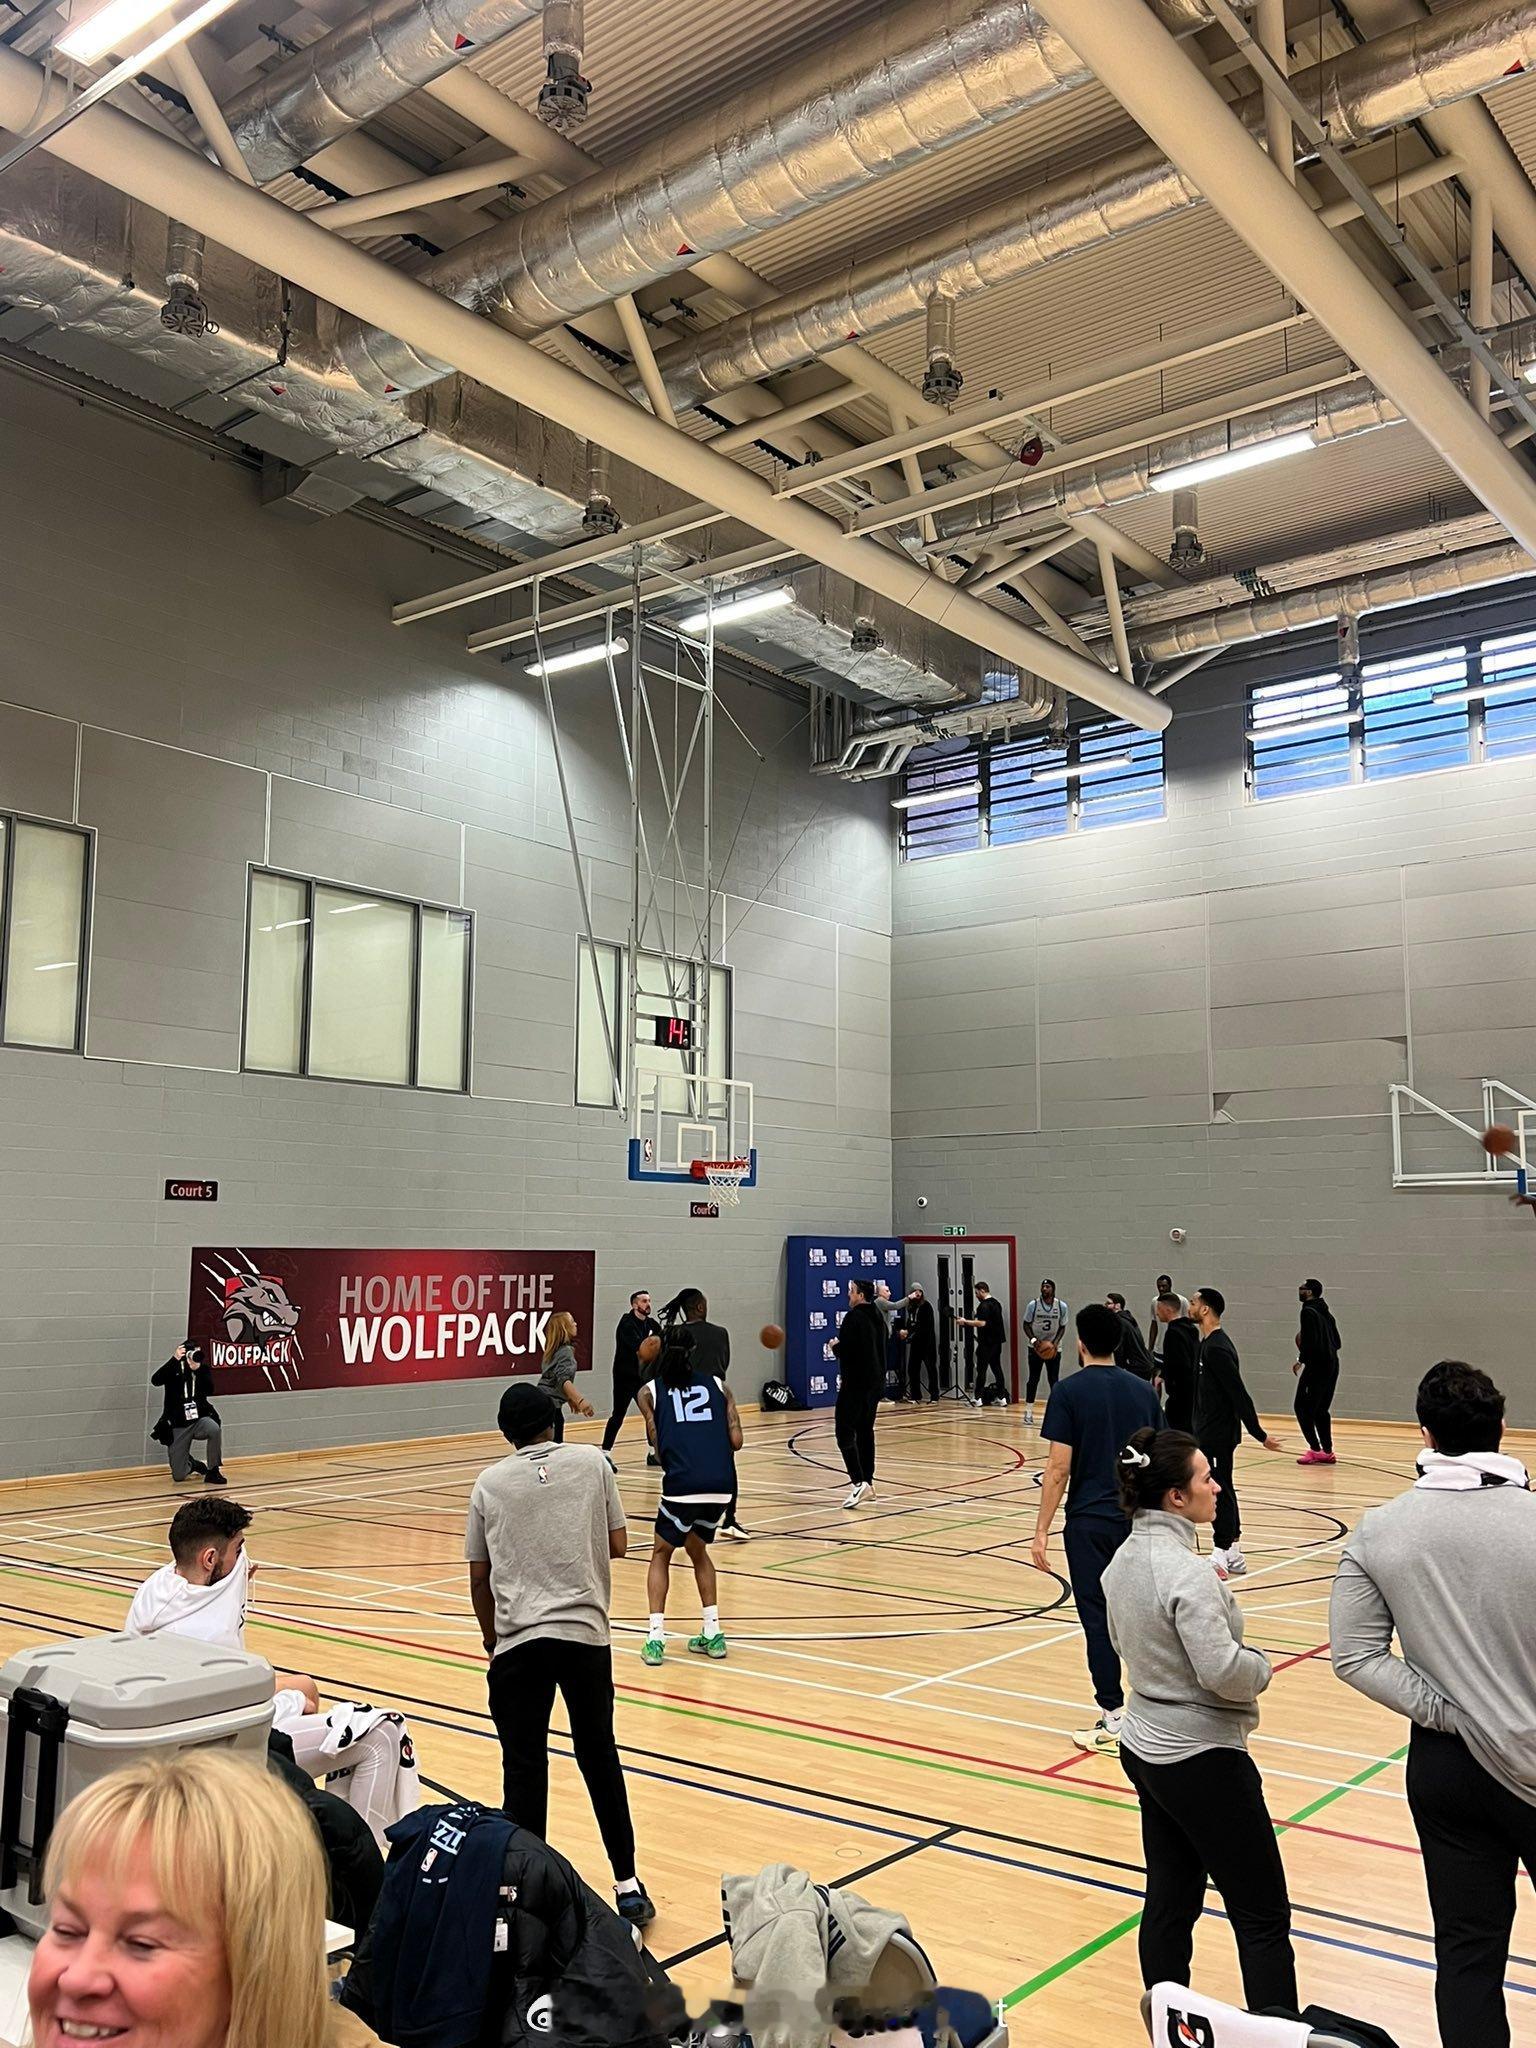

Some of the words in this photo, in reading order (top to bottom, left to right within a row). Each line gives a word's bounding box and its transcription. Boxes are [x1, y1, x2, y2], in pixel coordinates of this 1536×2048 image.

[668, 1018, 684, 1045] 14
[170, 1183, 202, 1197] Court
[205, 1185, 213, 1198] 5
[692, 1204, 711, 1215] Court
[339, 1275, 442, 1314] HOME
[451, 1274, 495, 1310] OF
[499, 1274, 554, 1308] THE
[339, 1310, 555, 1364] WOLFPACK
[1042, 1319, 1052, 1331] 3
[211, 1338, 292, 1367] WOLFPACK
[668, 1384, 713, 1423] 12
